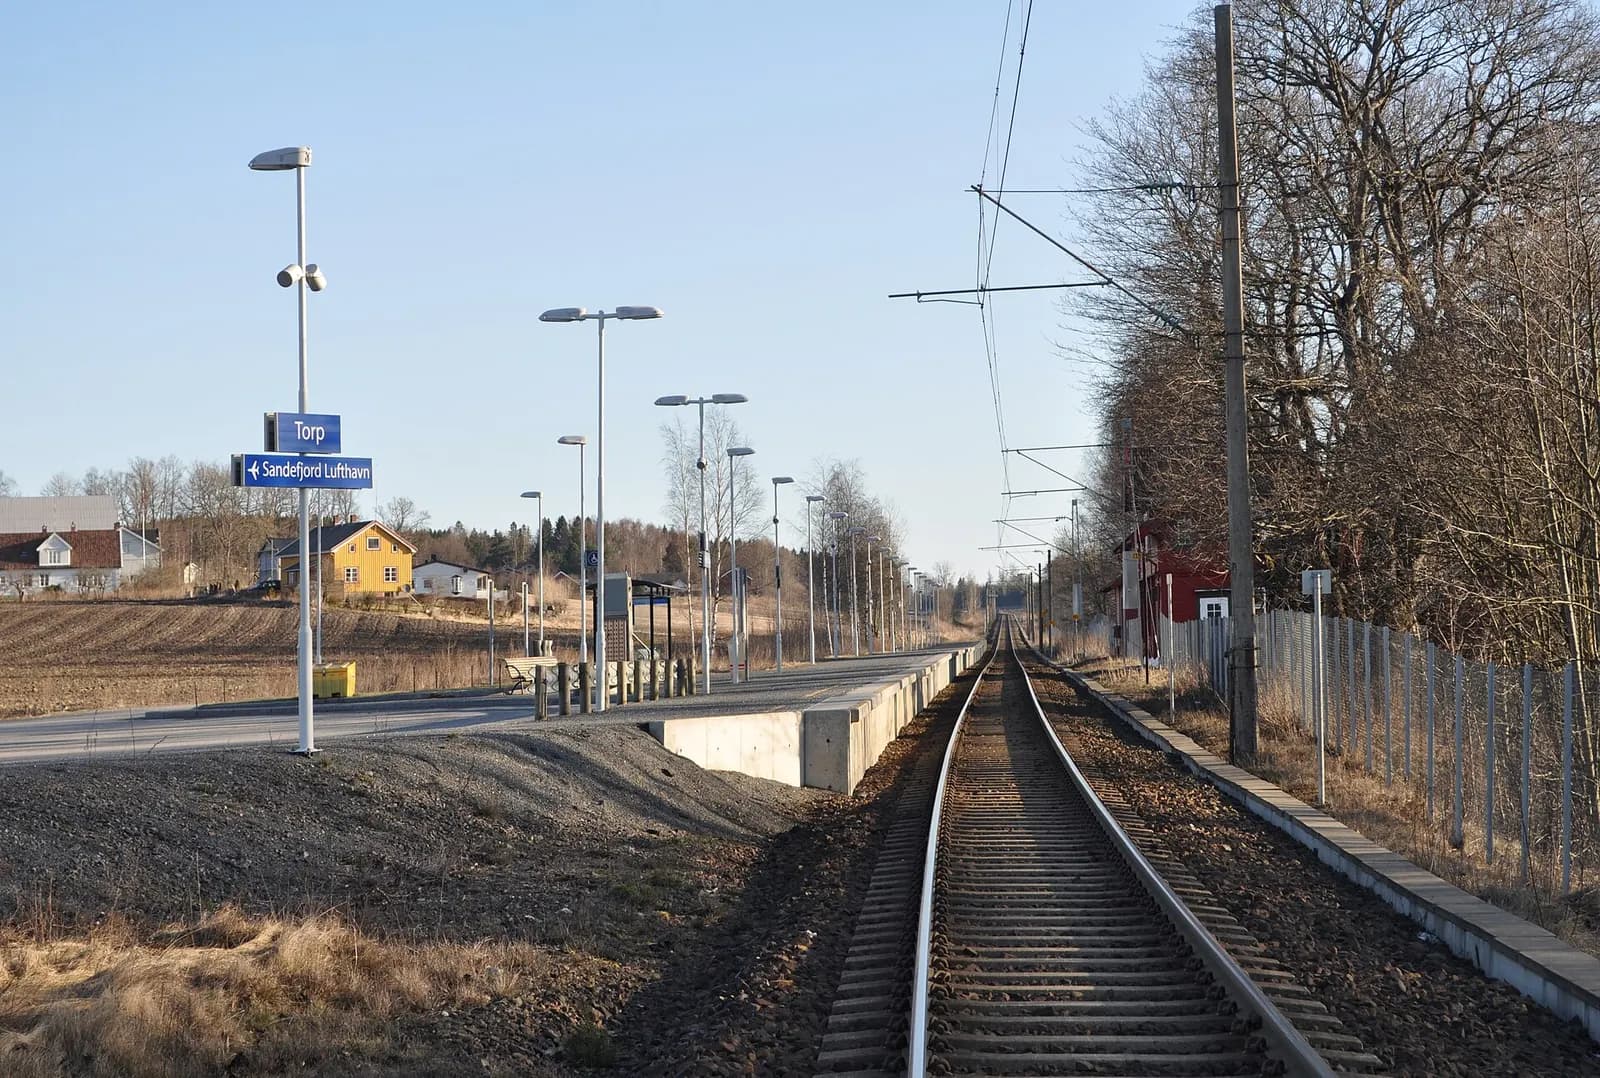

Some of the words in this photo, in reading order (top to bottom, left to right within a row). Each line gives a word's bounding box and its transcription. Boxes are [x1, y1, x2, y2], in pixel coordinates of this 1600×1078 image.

[294, 421, 325, 445] Torp
[262, 461, 322, 482] Sandefjord
[324, 463, 370, 480] Lufthavn
